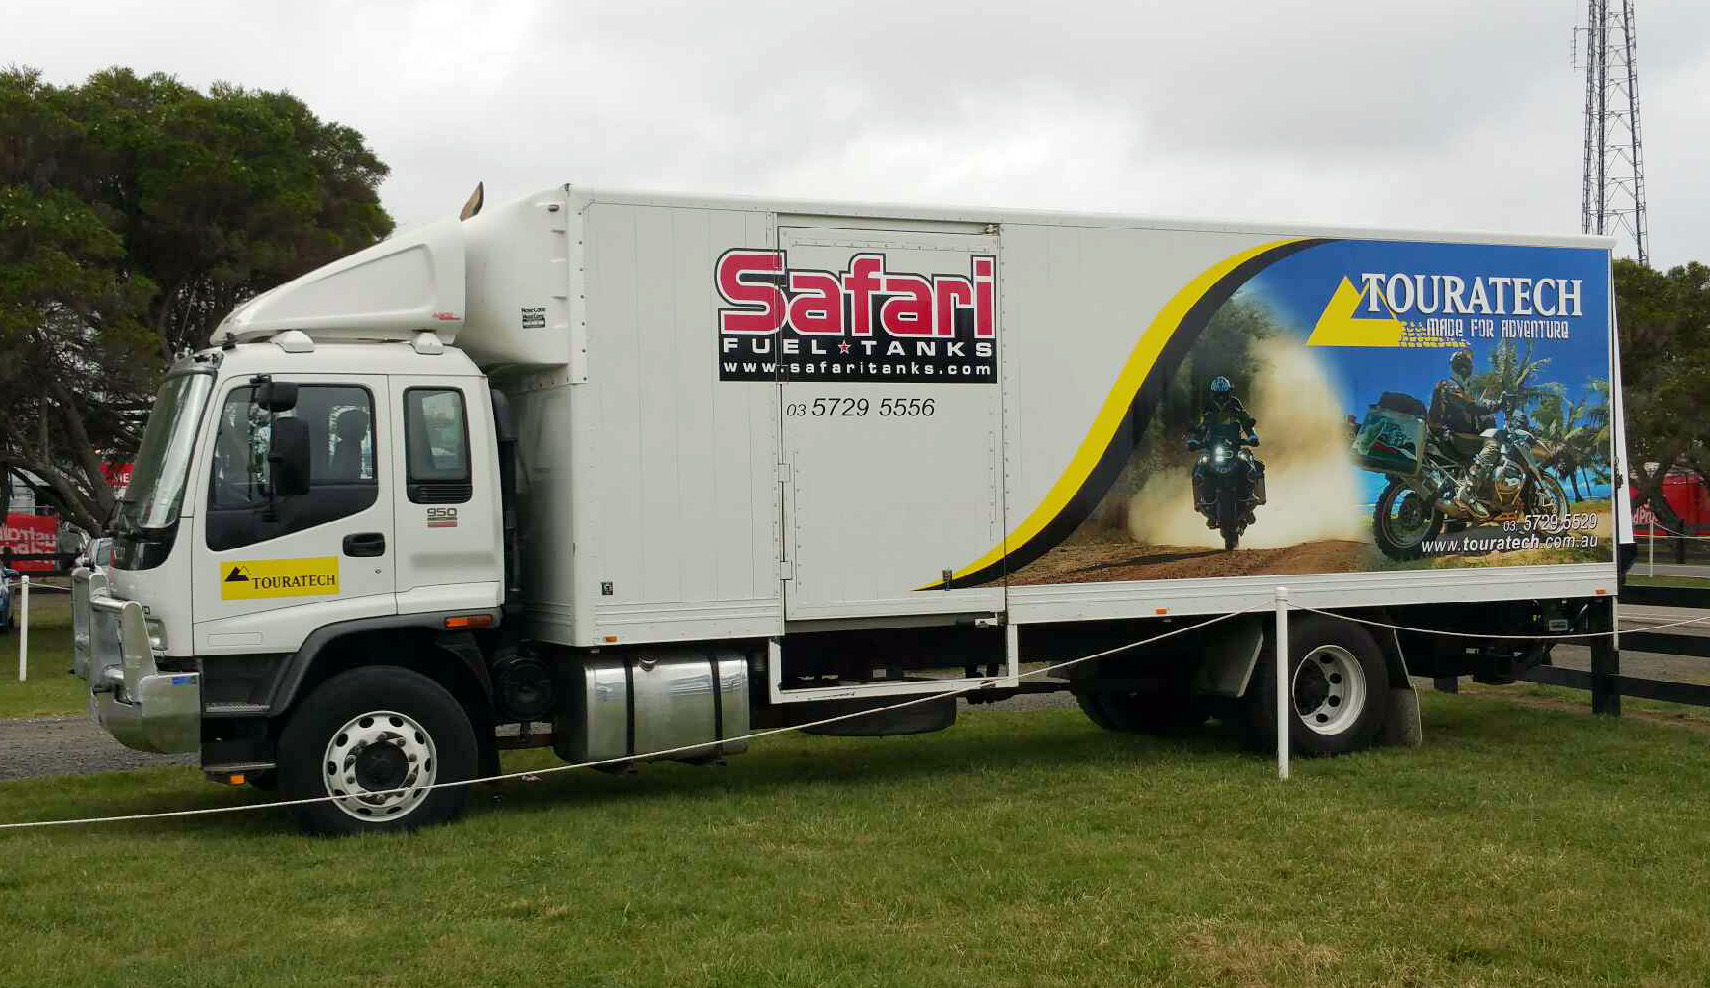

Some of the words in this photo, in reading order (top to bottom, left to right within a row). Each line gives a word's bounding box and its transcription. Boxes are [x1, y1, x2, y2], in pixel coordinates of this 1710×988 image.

[714, 248, 997, 338] Safari
[1361, 273, 1583, 316] TOURATECH
[1426, 318, 1463, 337] MADE
[1471, 319, 1495, 337] FOR
[1501, 319, 1569, 339] ADVENTURE
[723, 337, 827, 355] FUEL
[861, 339, 993, 357] TANKS
[723, 360, 992, 376] www.safaritanks.com
[786, 403, 807, 417] 03
[811, 397, 869, 417] 5729
[879, 397, 936, 417] 5556
[426, 507, 458, 517] 950
[1523, 514, 1559, 531] 5729
[1560, 513, 1598, 531] 5529
[1421, 533, 1598, 552] www.touratech.com.au
[251, 574, 335, 590] TOURATECH
